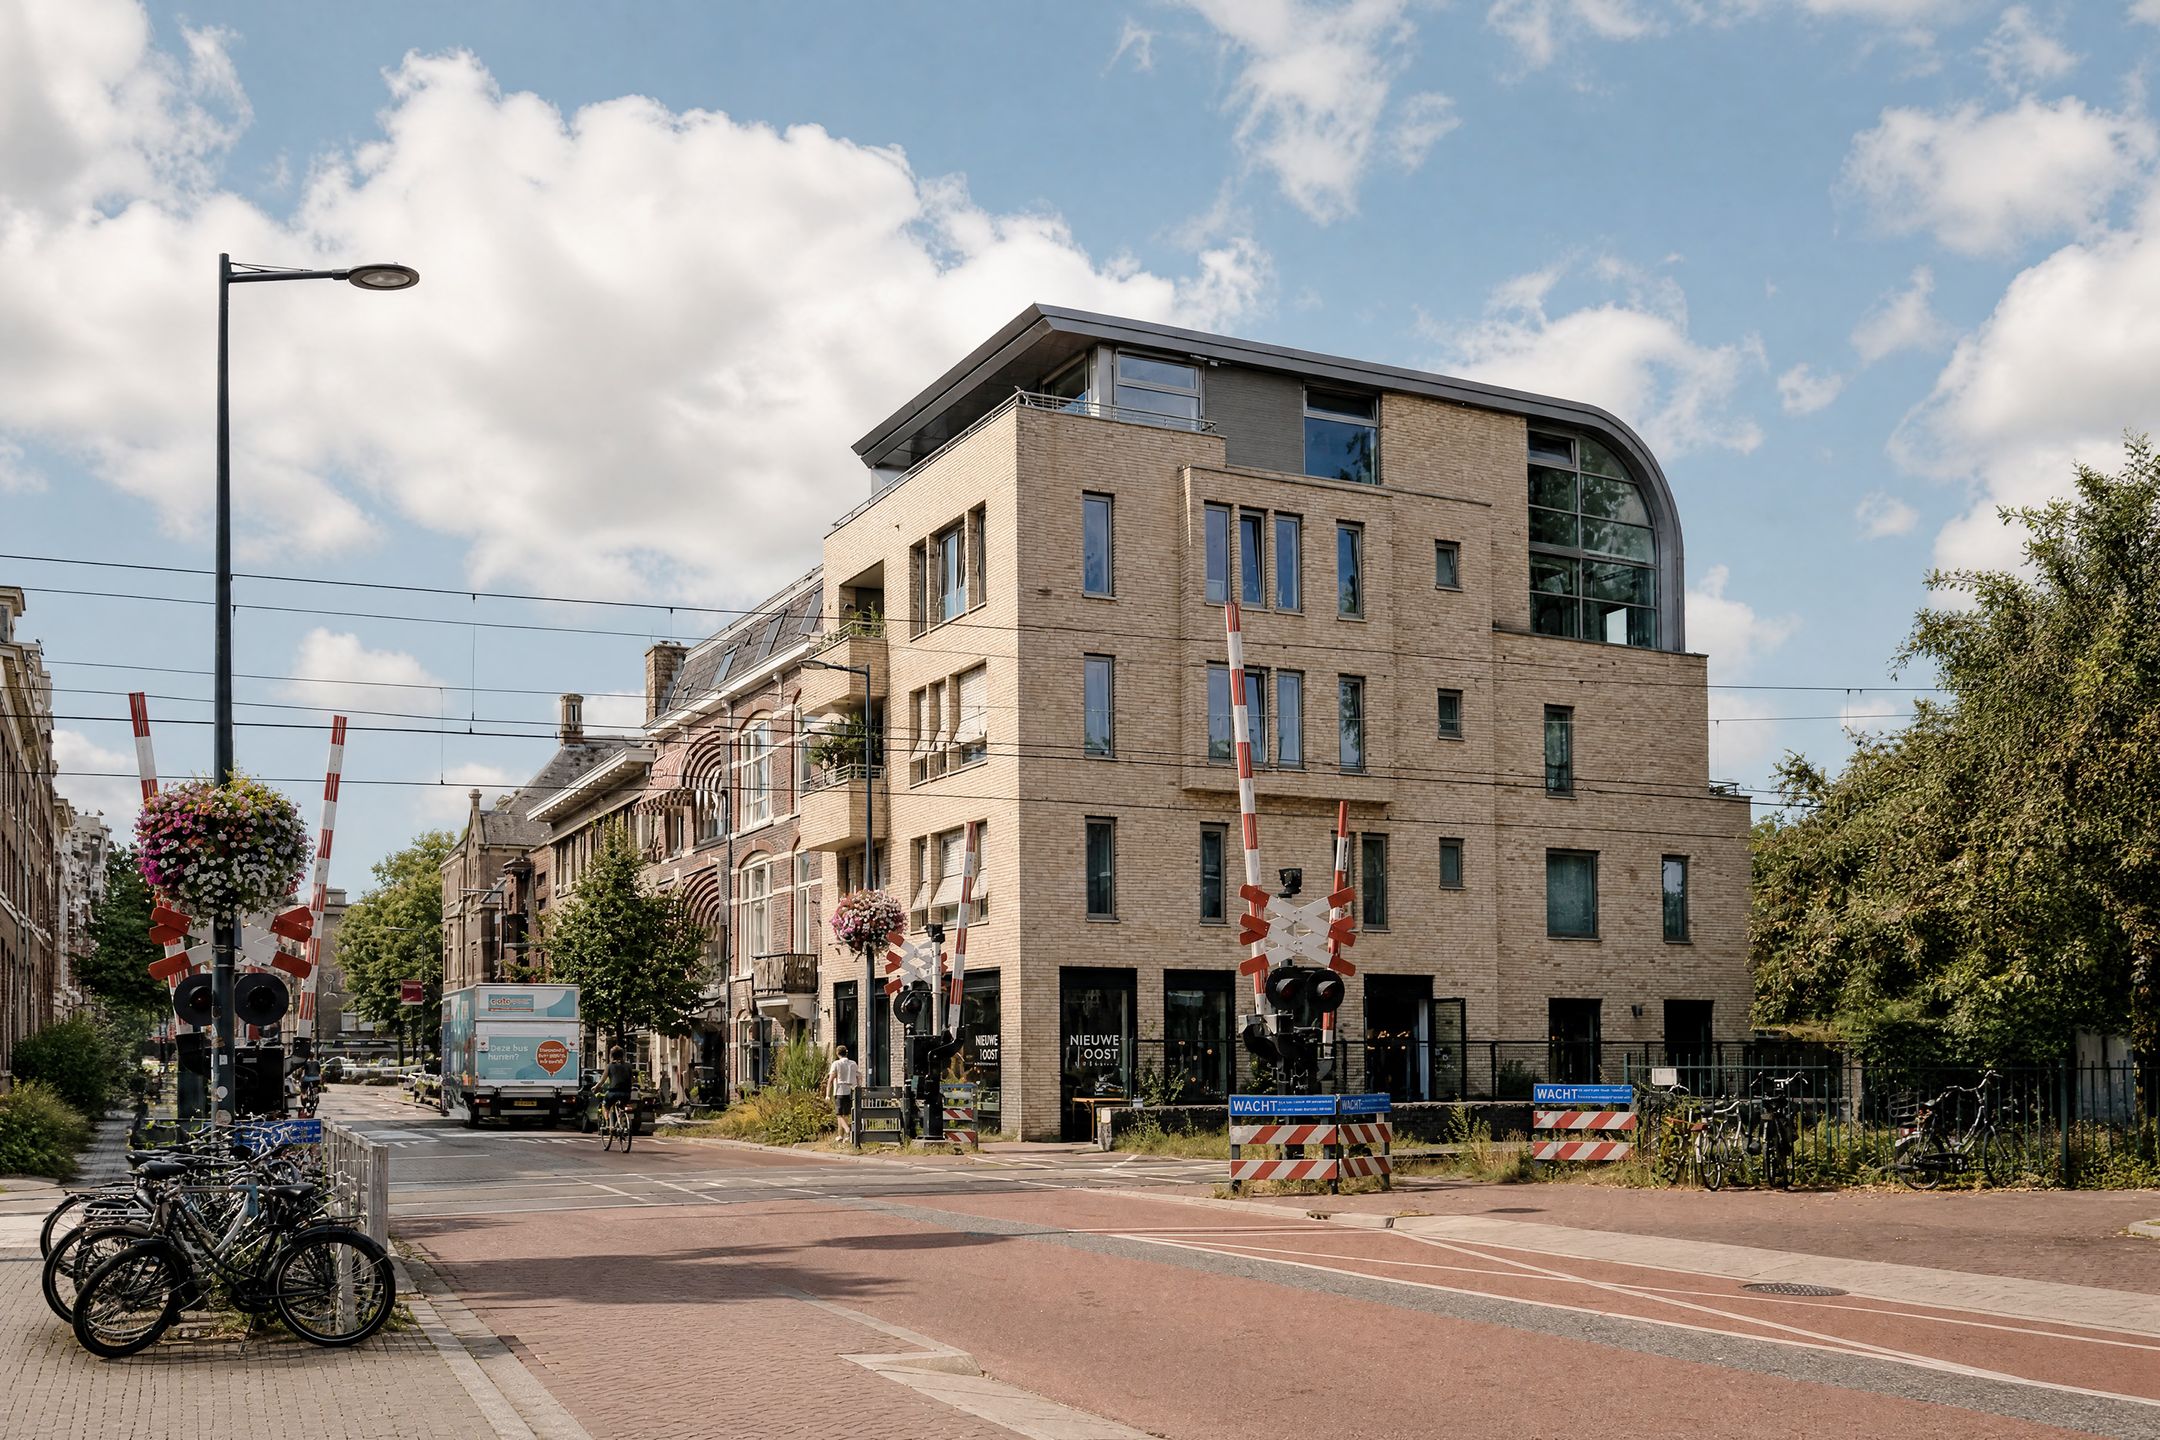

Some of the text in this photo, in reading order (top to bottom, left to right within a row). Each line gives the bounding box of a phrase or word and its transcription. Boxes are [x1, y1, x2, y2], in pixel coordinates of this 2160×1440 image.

[975, 1034, 998, 1046] NIEUWE
[1070, 1034, 1119, 1046] NIEUWE
[512, 1044, 529, 1052] bus
[1083, 1048, 1119, 1060] OOST
[1537, 1088, 1578, 1099] WACHT
[1233, 1100, 1278, 1112] WACHT
[1342, 1099, 1362, 1111] WACHT
